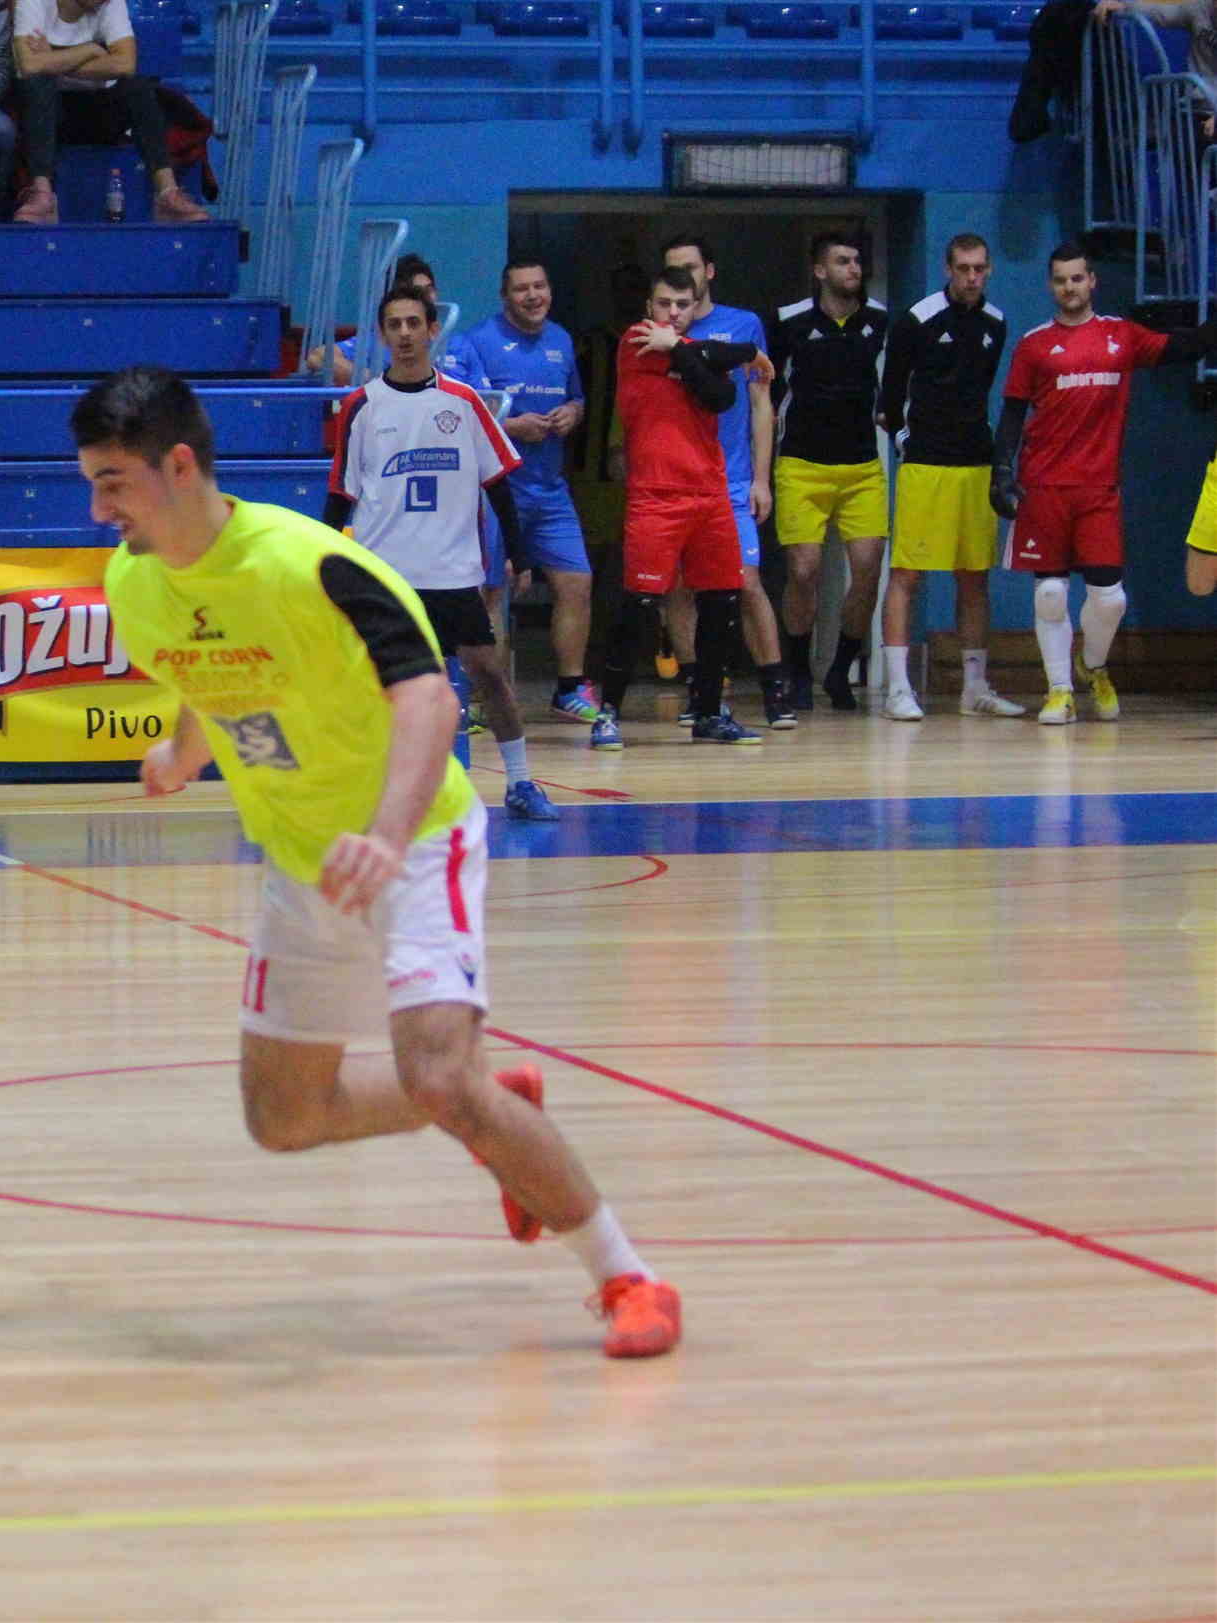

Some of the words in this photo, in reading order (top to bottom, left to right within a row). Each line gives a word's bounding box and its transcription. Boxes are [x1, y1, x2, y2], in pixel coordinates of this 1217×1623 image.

[410, 480, 432, 507] L
[153, 647, 202, 668] POP
[208, 645, 275, 665] CORN
[85, 706, 163, 739] Pivo
